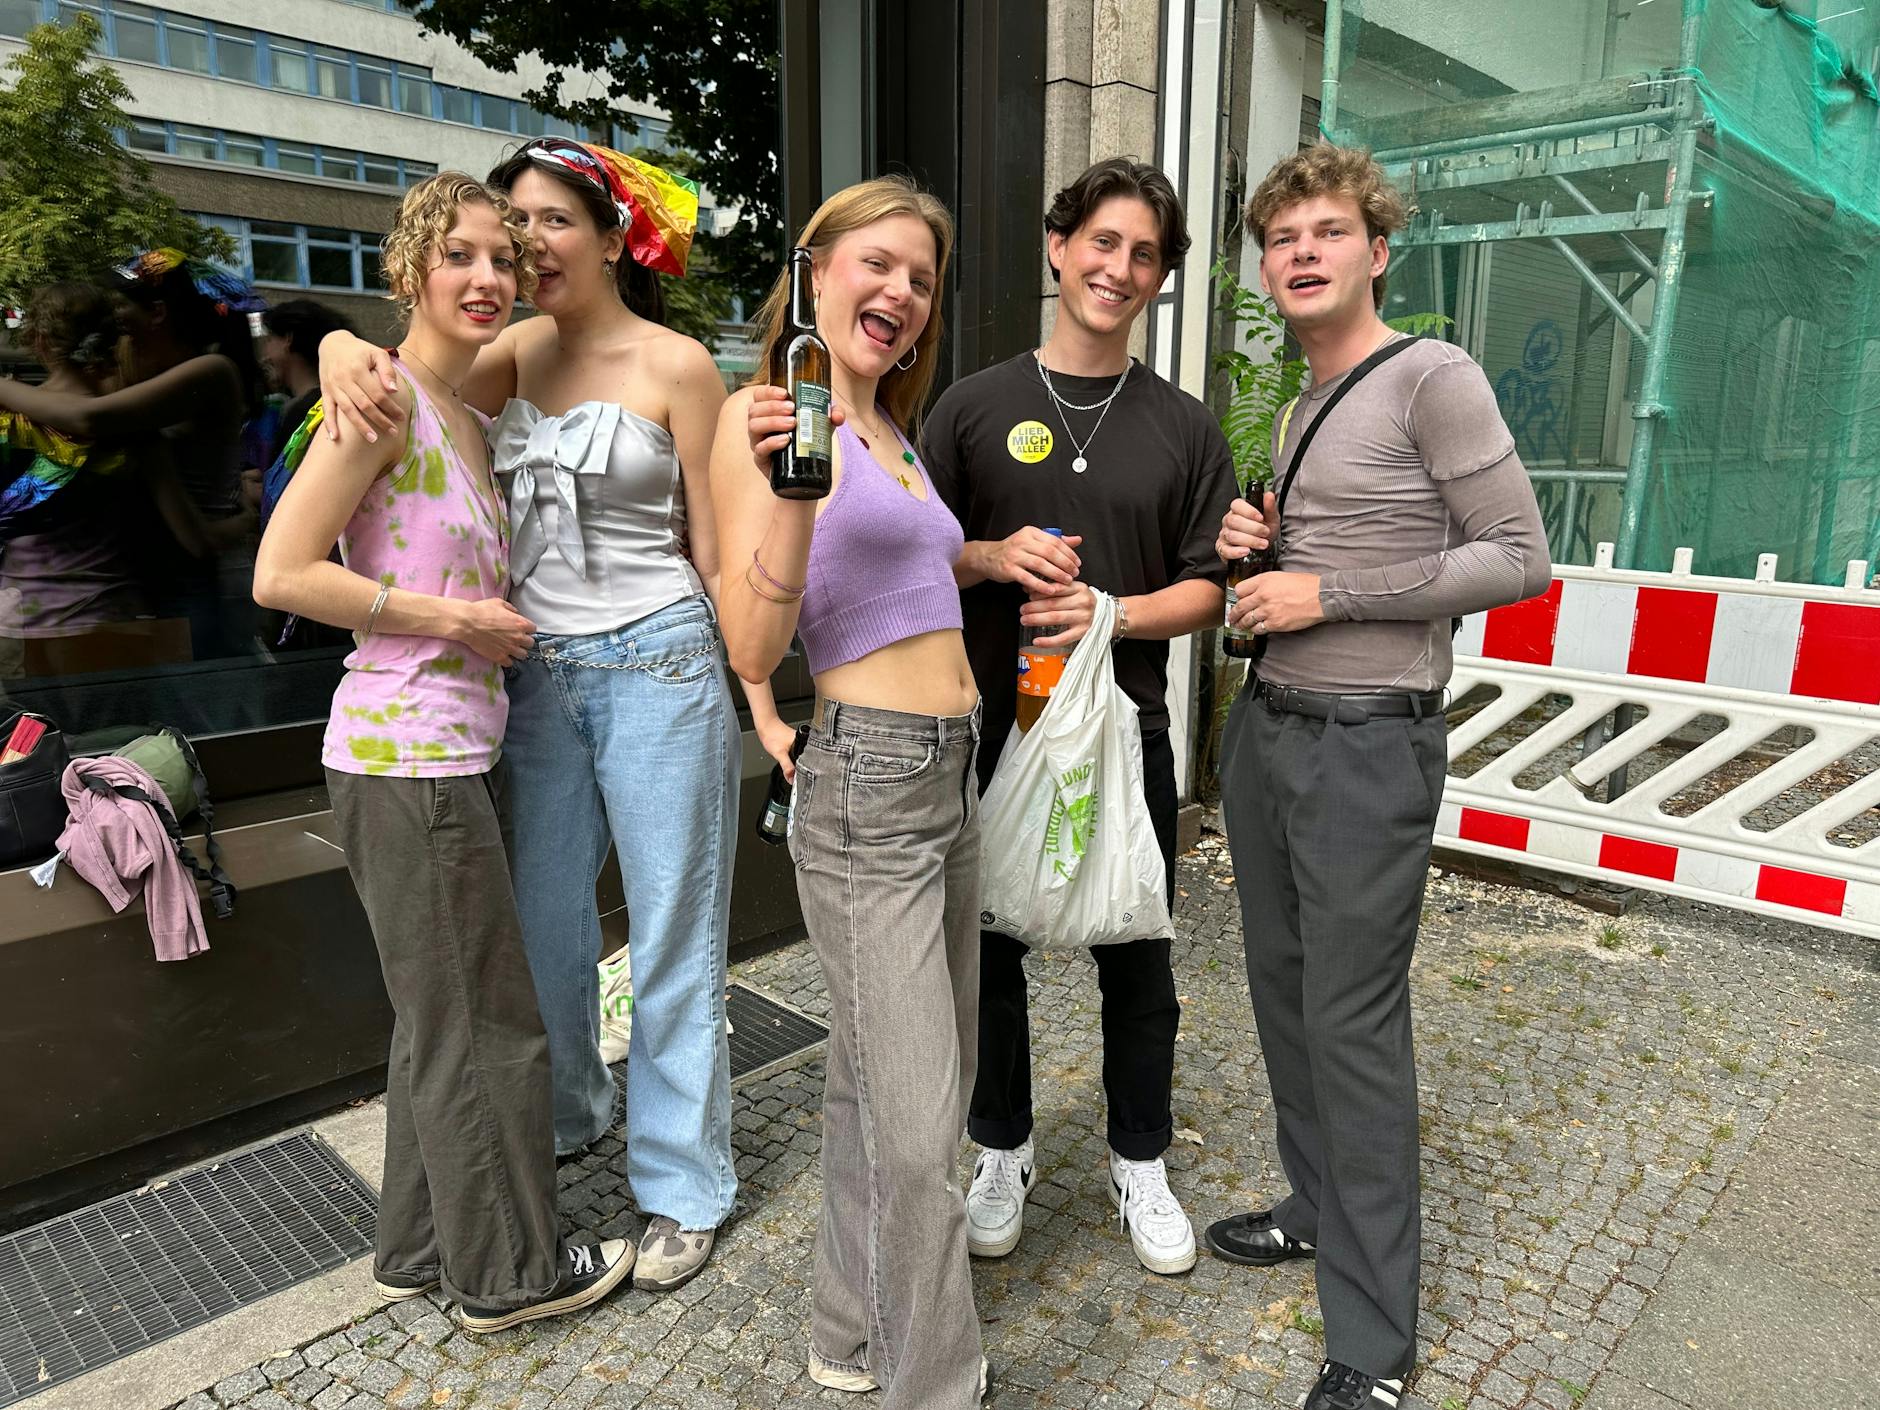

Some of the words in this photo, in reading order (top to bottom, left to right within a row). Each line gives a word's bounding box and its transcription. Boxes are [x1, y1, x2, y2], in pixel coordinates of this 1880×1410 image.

[1018, 427, 1044, 436] LIEB
[1012, 435, 1049, 446] MICH
[1016, 445, 1046, 454] ALLEE
